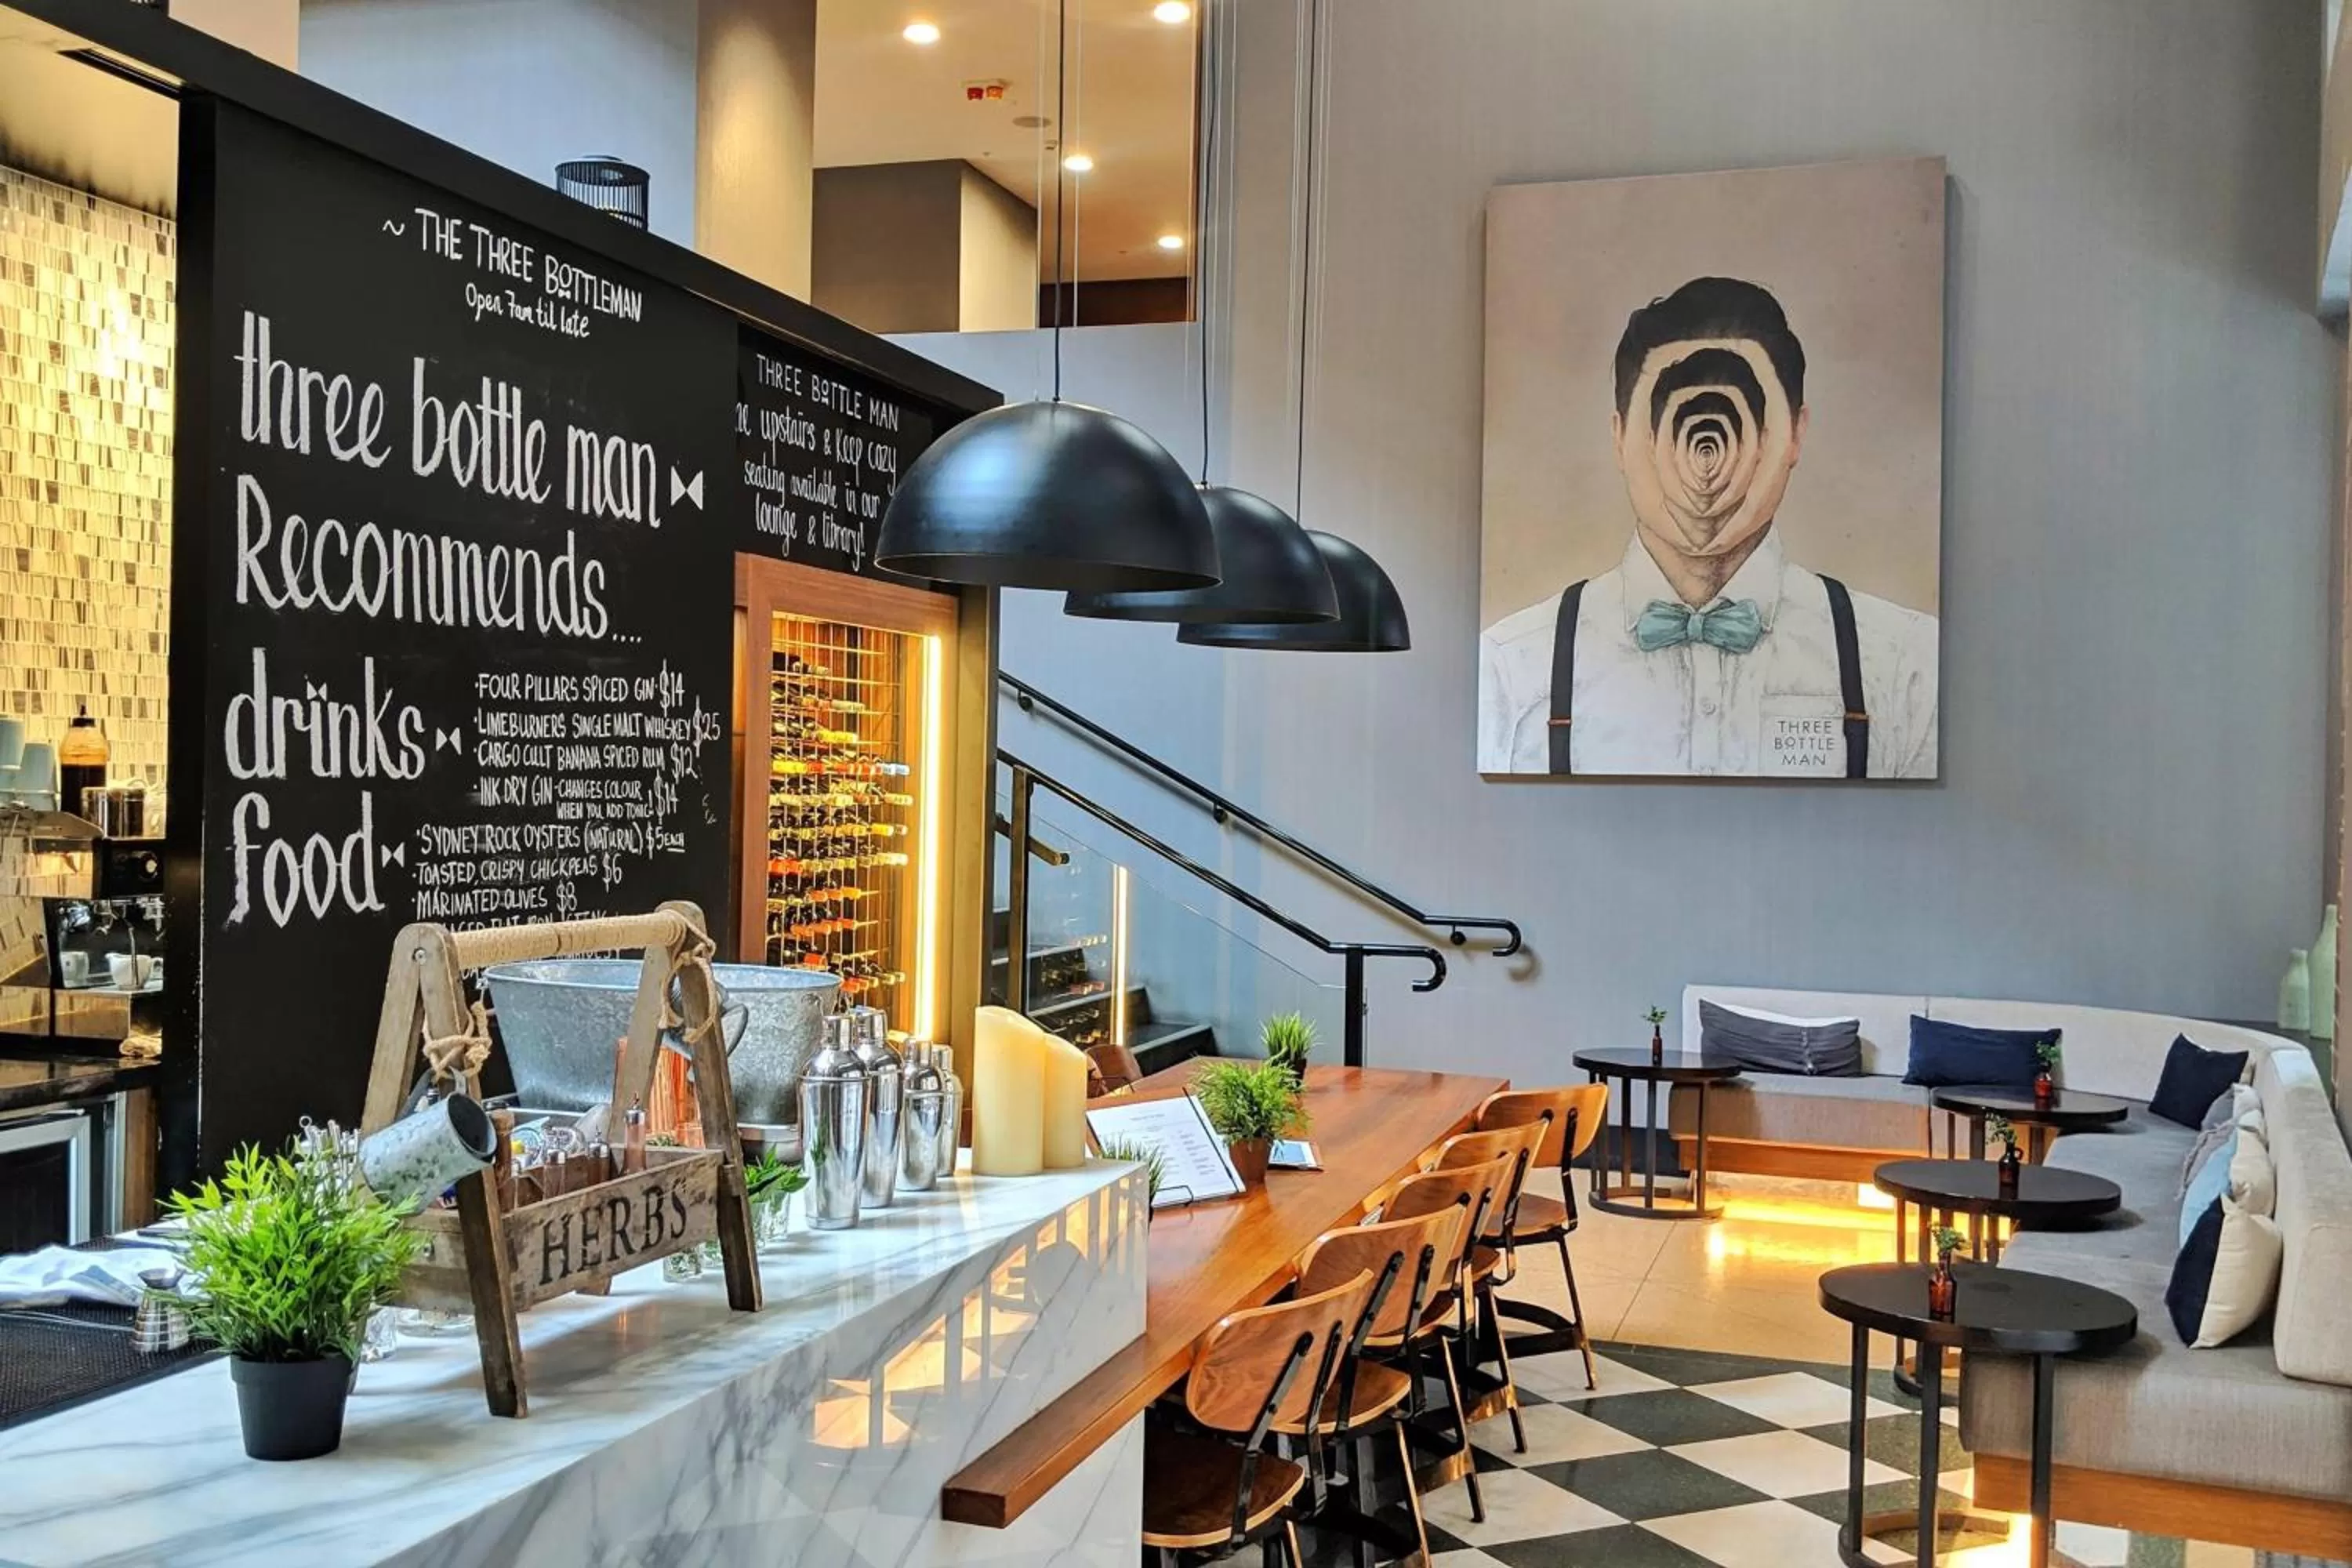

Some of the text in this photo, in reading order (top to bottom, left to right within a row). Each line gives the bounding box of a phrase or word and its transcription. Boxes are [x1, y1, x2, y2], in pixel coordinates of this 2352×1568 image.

[415, 208, 643, 322] THE THREE BOTTLEMAN
[466, 283, 503, 321] Open
[535, 296, 557, 330] til
[561, 306, 590, 337] late
[234, 310, 661, 528] three bottle man
[757, 354, 899, 432] THREE BOTTLE MAN
[760, 405, 816, 467] upstairs
[823, 429, 832, 456] &
[744, 452, 880, 518] seating available in our
[755, 492, 797, 557] lounge
[807, 514, 816, 546] &
[224, 647, 426, 780] drinks
[478, 673, 521, 700] FOUR
[524, 673, 579, 702] PILLARS
[583, 675, 629, 702] SPICED
[659, 658, 685, 717] $14
[477, 695, 720, 758] LIMEBURNERS SINGLE MALT WHISKEY $25
[1774, 736, 1835, 750] BOTTLE
[1777, 720, 1832, 734] THREE
[477, 739, 699, 785] CARGO CULT BANANA SPICED RUM $12
[1781, 753, 1826, 766] MAN
[480, 775, 501, 807] INK
[504, 775, 528, 807] DRY
[532, 774, 553, 807] GIN
[604, 779, 643, 801] COLOUR
[654, 768, 680, 825] $14
[556, 800, 583, 820] WHEN
[586, 802, 604, 819] YOU
[606, 802, 623, 819] ADD
[223, 790, 386, 931] food
[421, 823, 479, 856] SYDNEY
[485, 824, 521, 854] ROCK
[524, 823, 581, 851] OYSTERS
[416, 885, 500, 920] MARINATED
[504, 885, 548, 909] OLIVES
[556, 880, 578, 921] $8
[481, 858, 524, 884] CRISPY
[530, 854, 598, 881] CHICKPEAS
[602, 851, 622, 893] $6
[539, 1177, 688, 1286] HERBS
